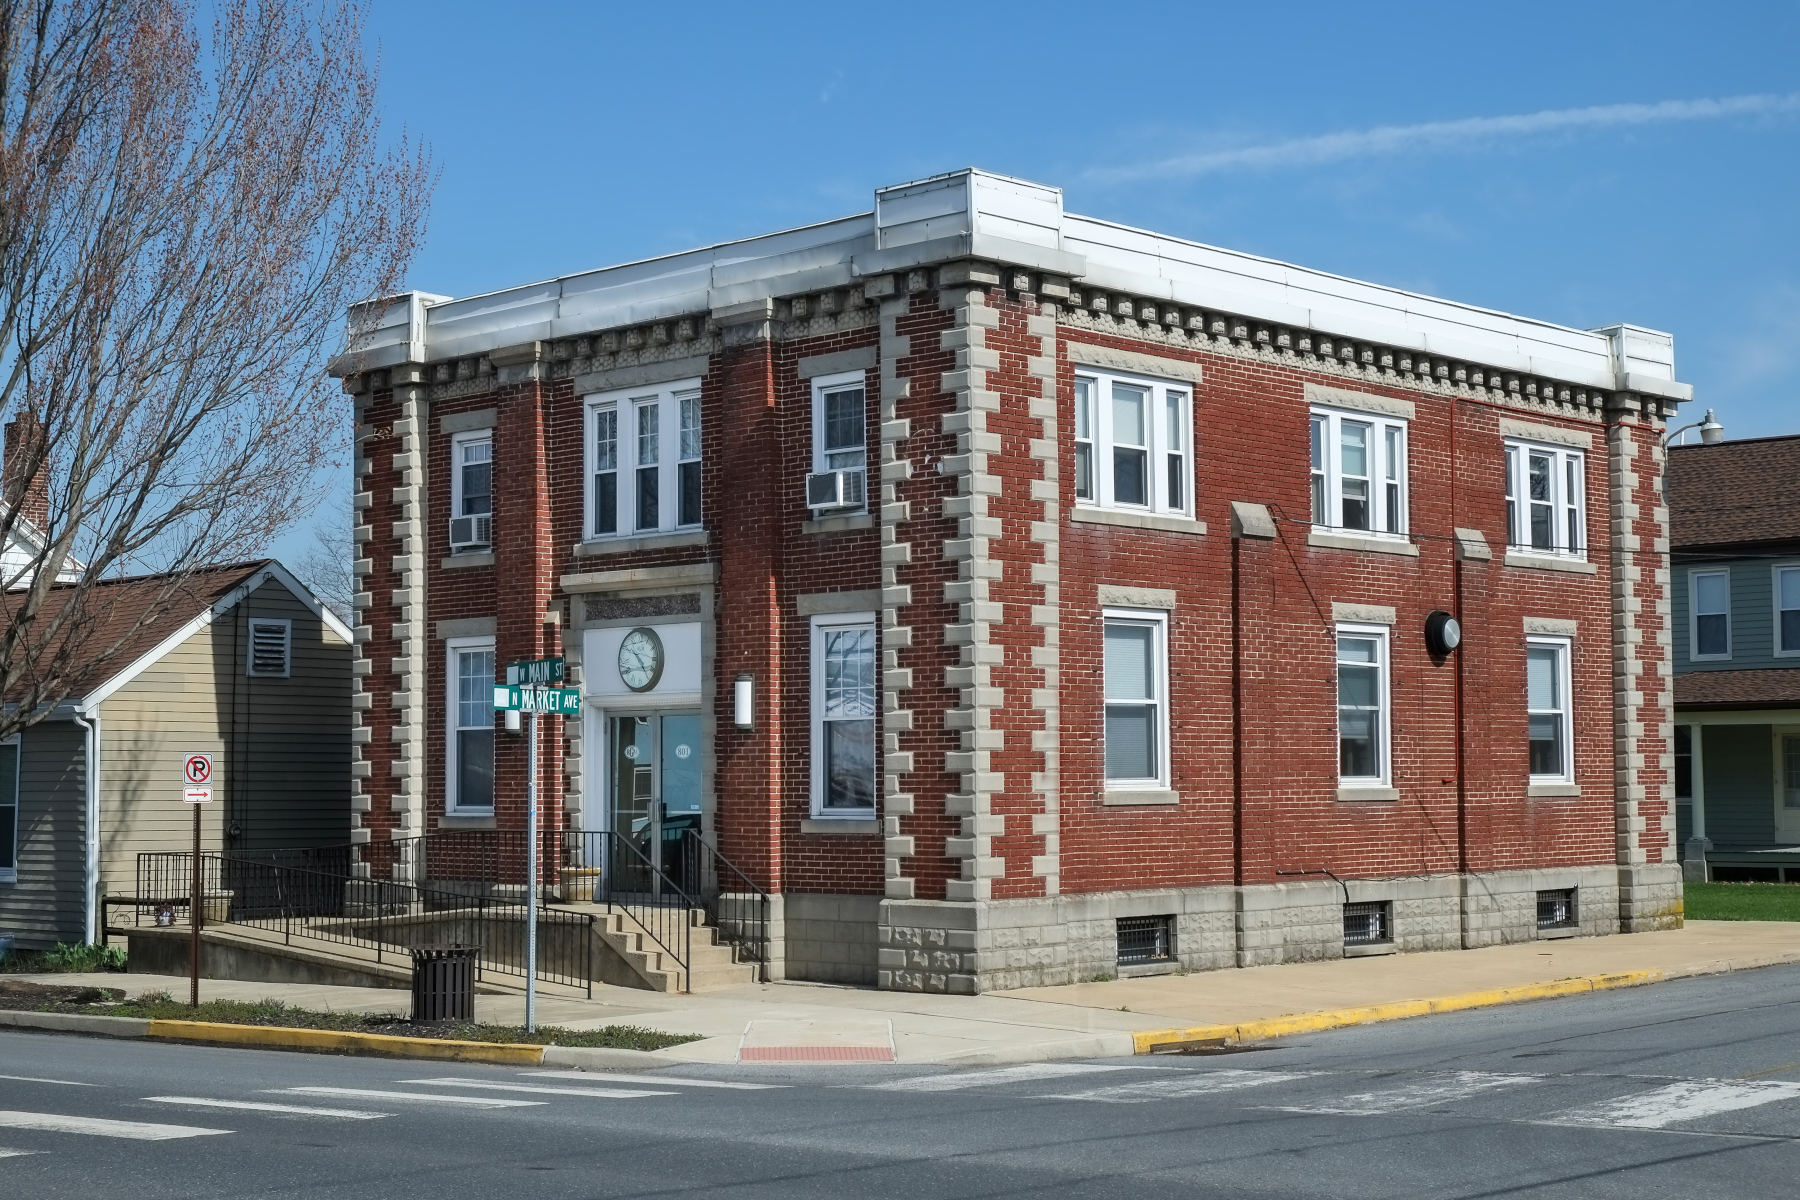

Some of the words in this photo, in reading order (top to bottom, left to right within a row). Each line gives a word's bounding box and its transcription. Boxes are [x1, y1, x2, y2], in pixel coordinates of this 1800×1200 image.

[520, 668, 525, 682] W
[529, 661, 550, 682] MAIN
[555, 663, 563, 677] ST
[512, 692, 518, 706] N
[522, 690, 560, 710] MARKET
[564, 695, 578, 708] AVE
[677, 746, 689, 756] 801
[193, 761, 205, 777] P
